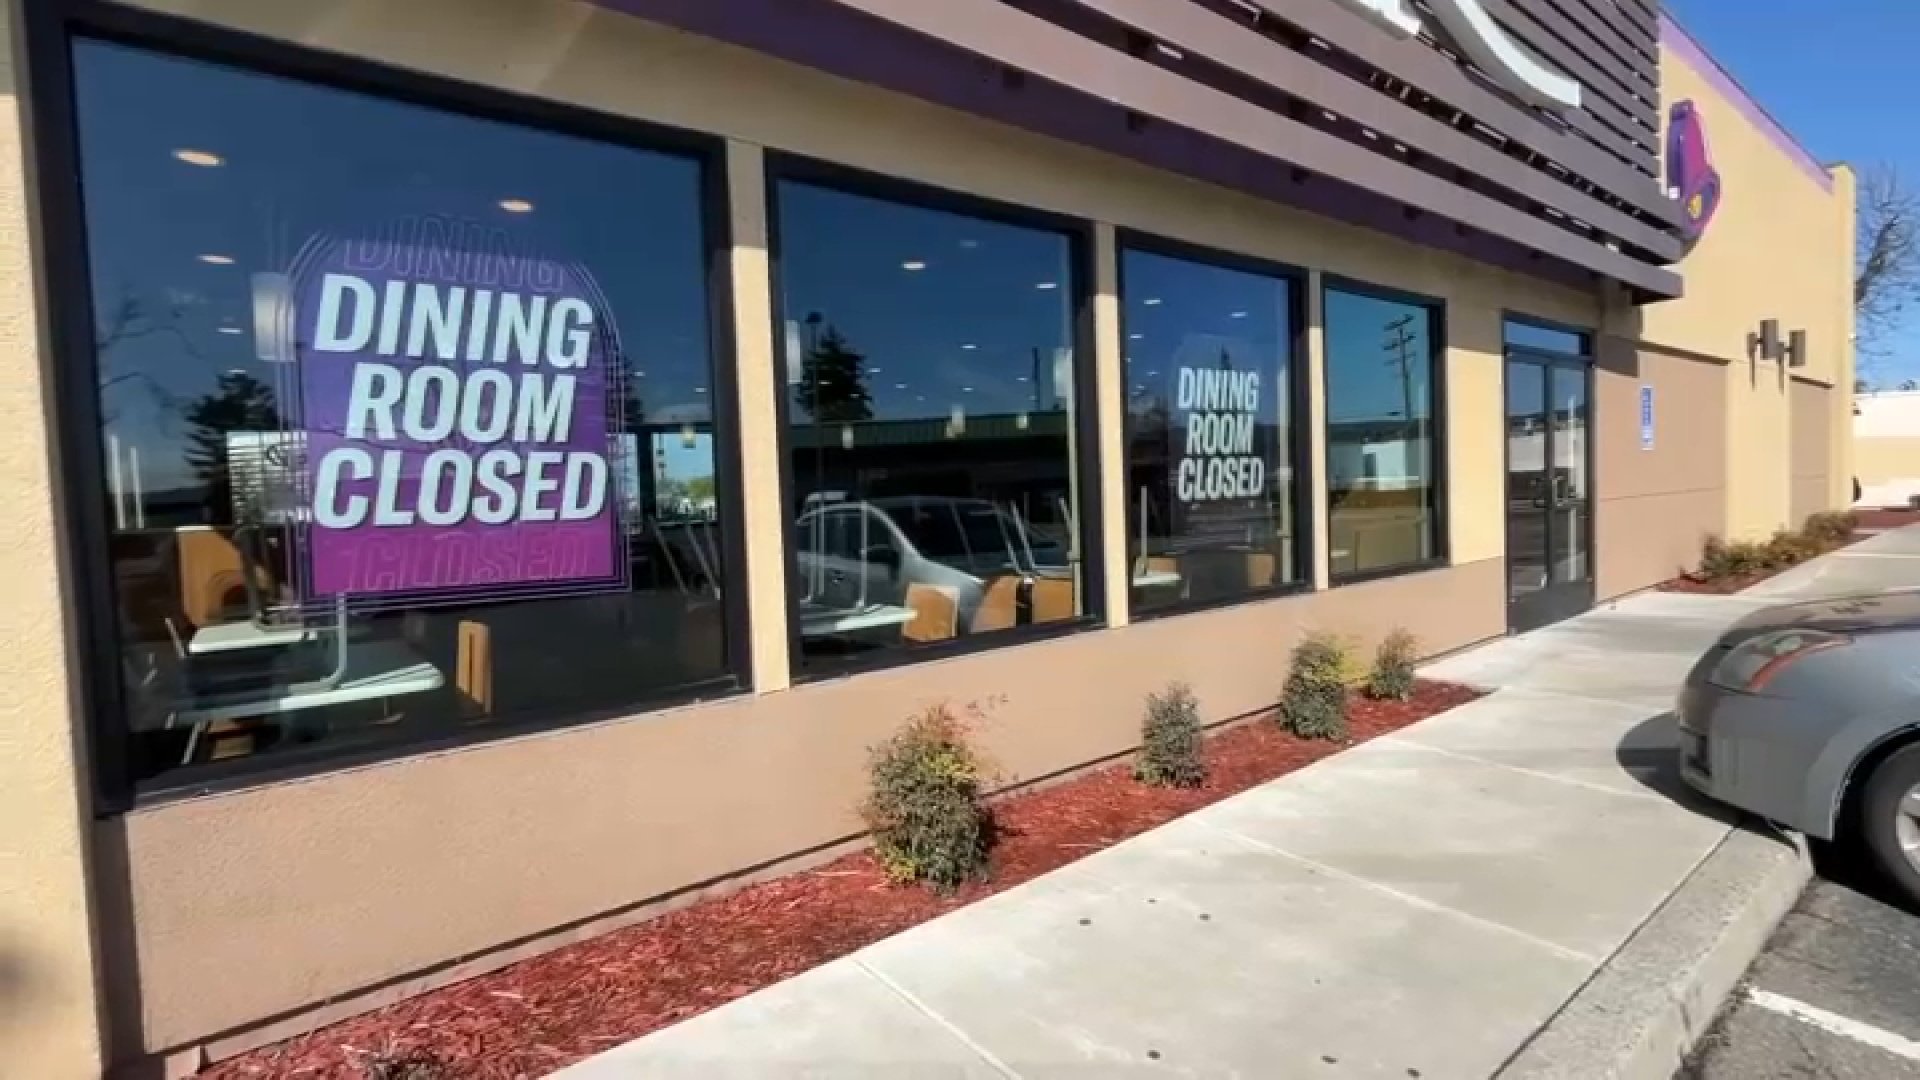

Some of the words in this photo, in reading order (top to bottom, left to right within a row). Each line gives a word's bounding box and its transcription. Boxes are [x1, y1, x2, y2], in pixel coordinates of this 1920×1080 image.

[314, 273, 594, 369] DINING
[345, 361, 577, 443] ROOM
[1178, 367, 1260, 411] DINING
[1186, 412, 1255, 455] ROOM
[314, 447, 608, 529] CLOSED
[1178, 457, 1265, 502] CLOSED
